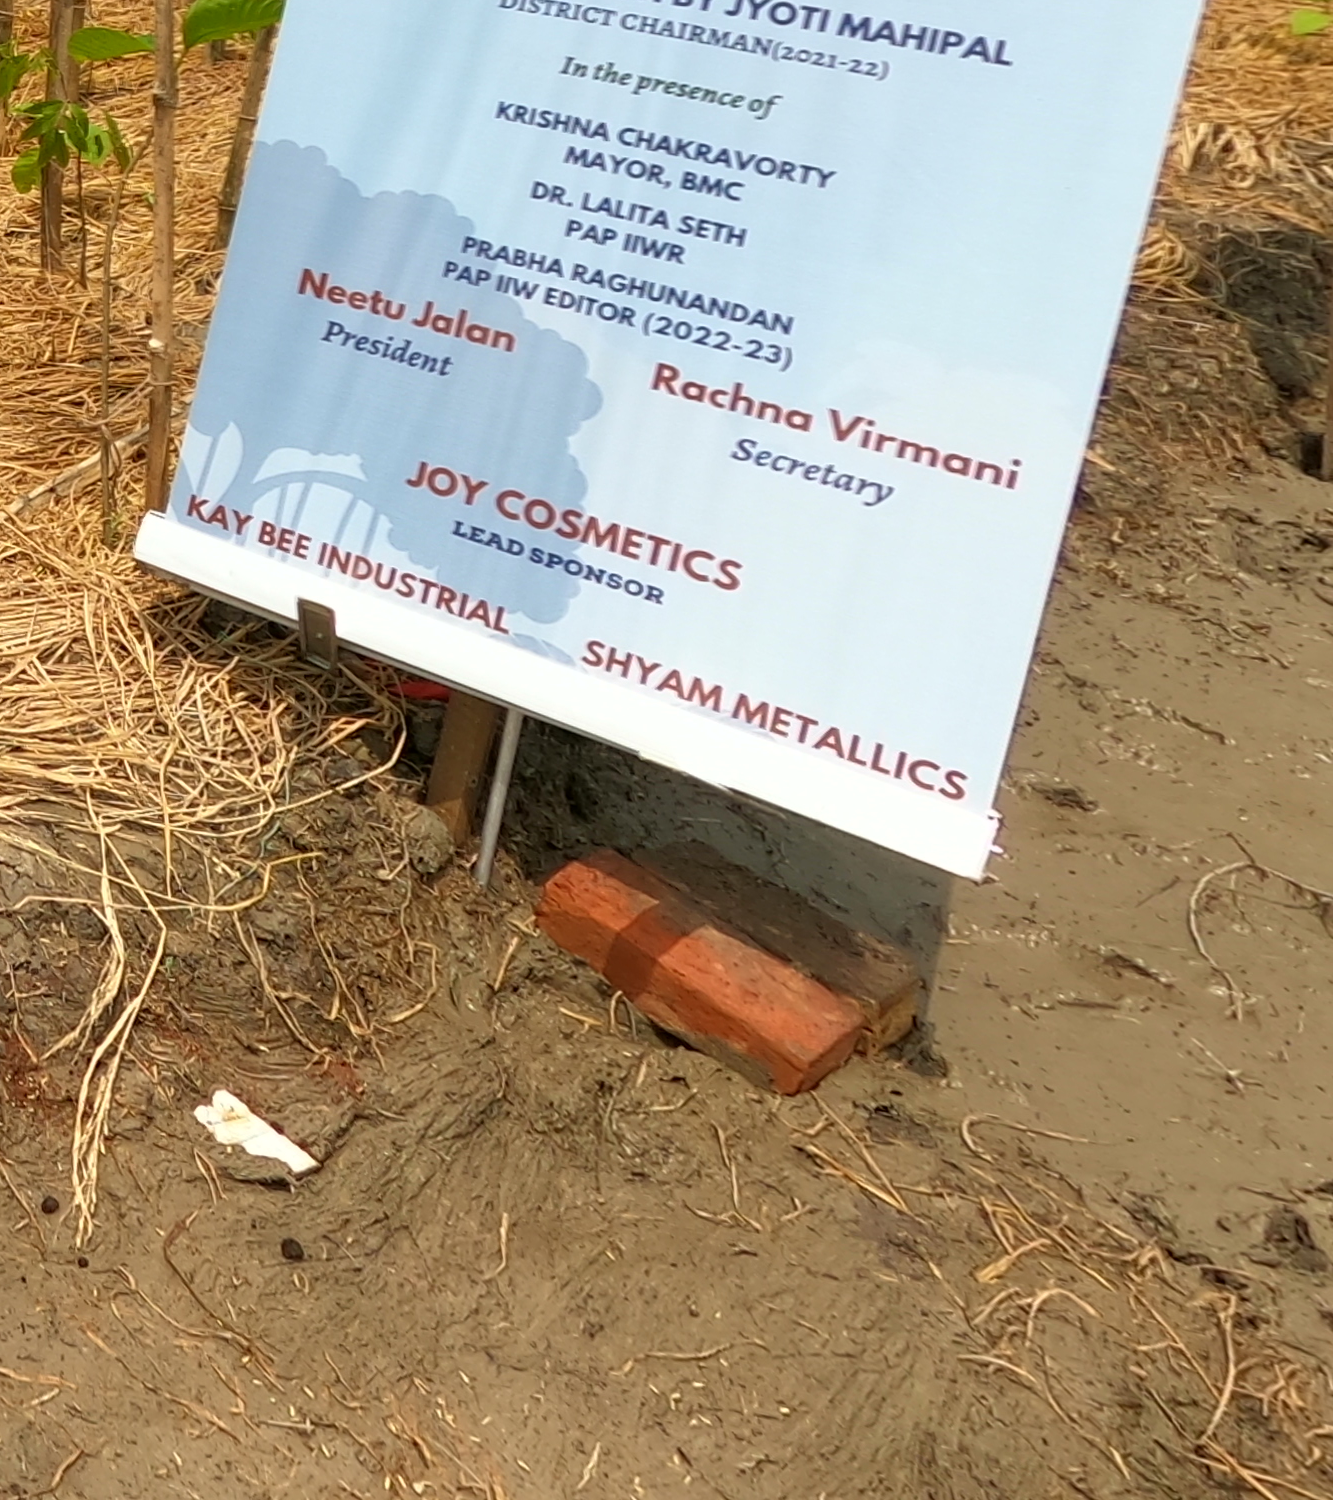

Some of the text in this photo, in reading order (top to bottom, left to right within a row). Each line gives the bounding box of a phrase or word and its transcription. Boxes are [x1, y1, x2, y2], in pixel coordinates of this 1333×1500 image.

[620, 14, 889, 80] CHAIRMAN(2021-22)
[836, 13, 1013, 66] MAHIPAL
[559, 57, 783, 120] In the presence of
[496, 101, 837, 188] KRISHNA CHAKRAVORTY
[564, 146, 745, 201] MAYOR, BMC
[530, 181, 747, 247] DR. LALITA SETH
[565, 219, 685, 264] PAP IIWR
[298, 268, 515, 352] Neetu Jalan
[442, 261, 792, 372] PAP IIW EDITOR (2022-23)
[461, 236, 794, 335] PRABHA RAGHUNANDAN
[321, 321, 453, 376] President
[651, 363, 1022, 489] Rachna Virmani
[730, 439, 894, 506] Secretary
[186, 494, 509, 635] KAY BEE INDUSTRIAL
[405, 461, 743, 590] JOY COSMETICS
[452, 521, 664, 605] LEAD SPONSOR
[581, 640, 968, 800] SHYAM METALLICS
